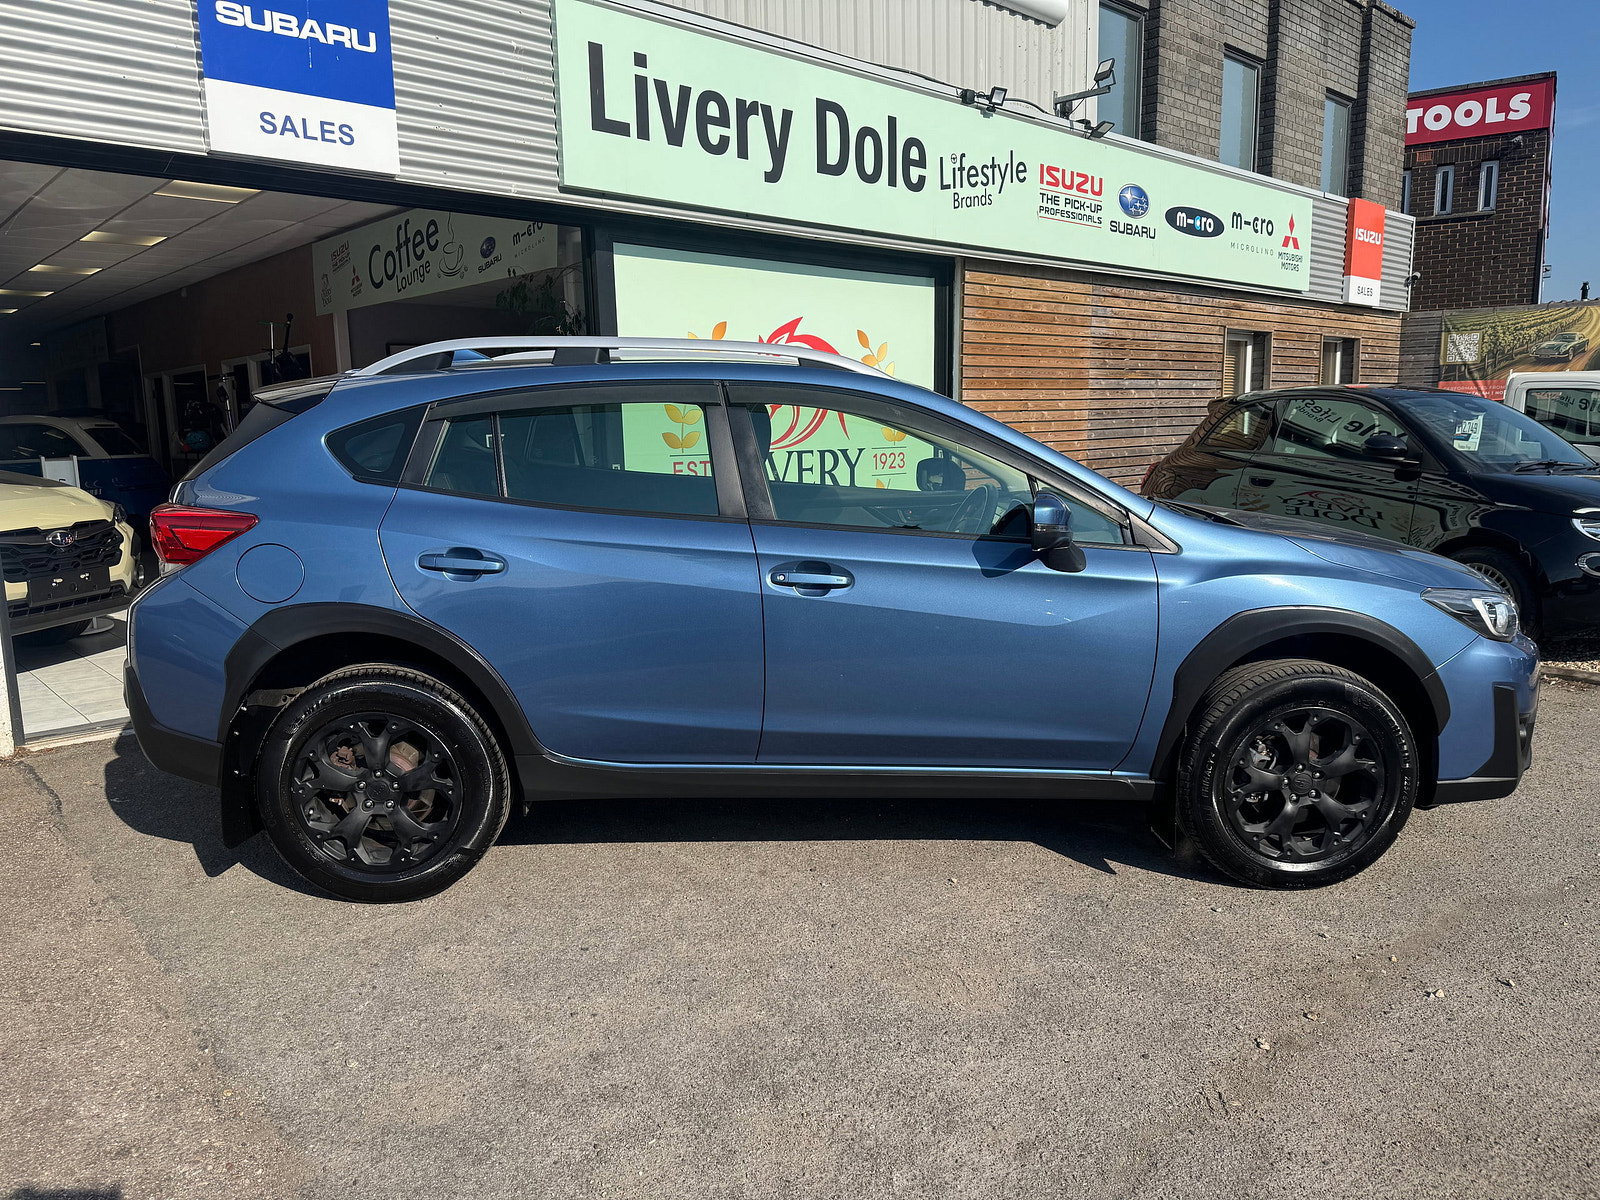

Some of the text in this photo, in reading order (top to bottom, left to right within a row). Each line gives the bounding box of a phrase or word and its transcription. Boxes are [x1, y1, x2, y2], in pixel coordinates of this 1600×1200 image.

[215, 0, 377, 53] SUBARU
[588, 41, 927, 193] Livery Dole
[1406, 93, 1531, 134] TOOLS
[259, 111, 355, 146] SALES
[939, 150, 1027, 194] Lifestyle
[1039, 163, 1103, 197] ISUZU
[953, 188, 993, 209] Brands
[1039, 192, 1103, 214] THE PICK-UP
[1039, 205, 1103, 225] PROFESSIONALS
[1109, 220, 1156, 240] SUBARU
[1355, 227, 1382, 245] ISUZU
[368, 218, 439, 289] Coffee
[1230, 241, 1274, 257] MICROLINO
[1278, 251, 1303, 264] MITSUBISHI
[477, 253, 502, 274] SUBARU
[1281, 262, 1300, 272] MOTORS
[396, 260, 431, 293] Lounge
[1357, 286, 1373, 297] SALES
[765, 447, 867, 487] VERY
[871, 452, 906, 471] 1923
